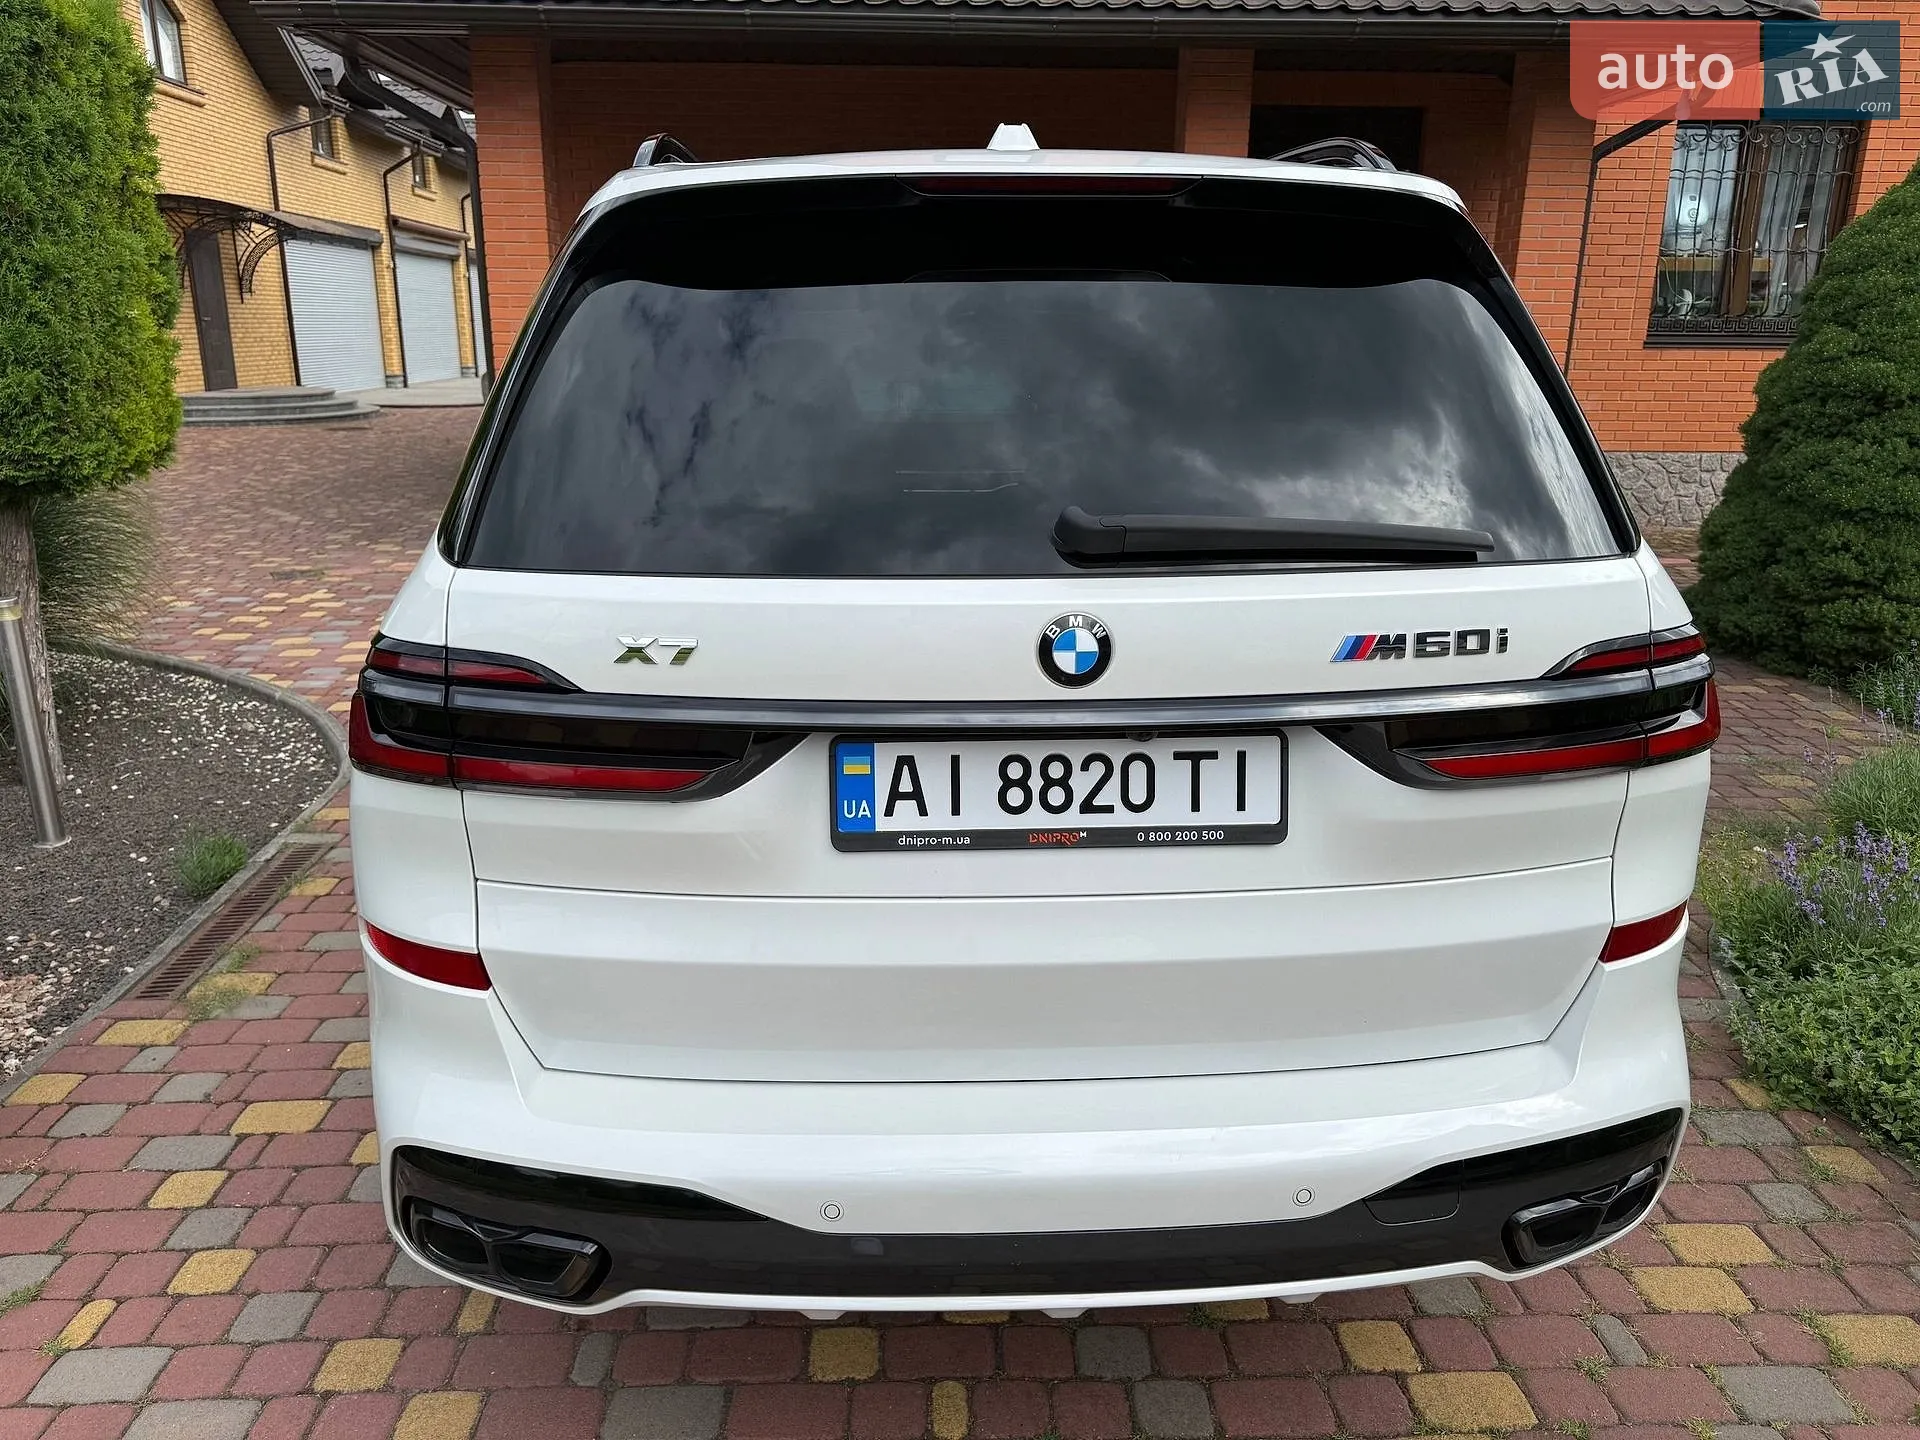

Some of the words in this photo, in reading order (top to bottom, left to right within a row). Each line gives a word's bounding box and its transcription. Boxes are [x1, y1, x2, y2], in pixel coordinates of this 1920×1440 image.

[1046, 615, 1106, 640] BMW
[613, 635, 698, 665] X7
[883, 754, 961, 817] AI
[997, 751, 1156, 815] 8820
[1172, 749, 1247, 812] TI
[843, 800, 872, 818] UA
[898, 835, 971, 846] dnipro-m.ua
[1137, 832, 1145, 841] 0
[1148, 832, 1172, 841] 800
[1175, 831, 1198, 841] 200
[1201, 831, 1224, 840] 500
